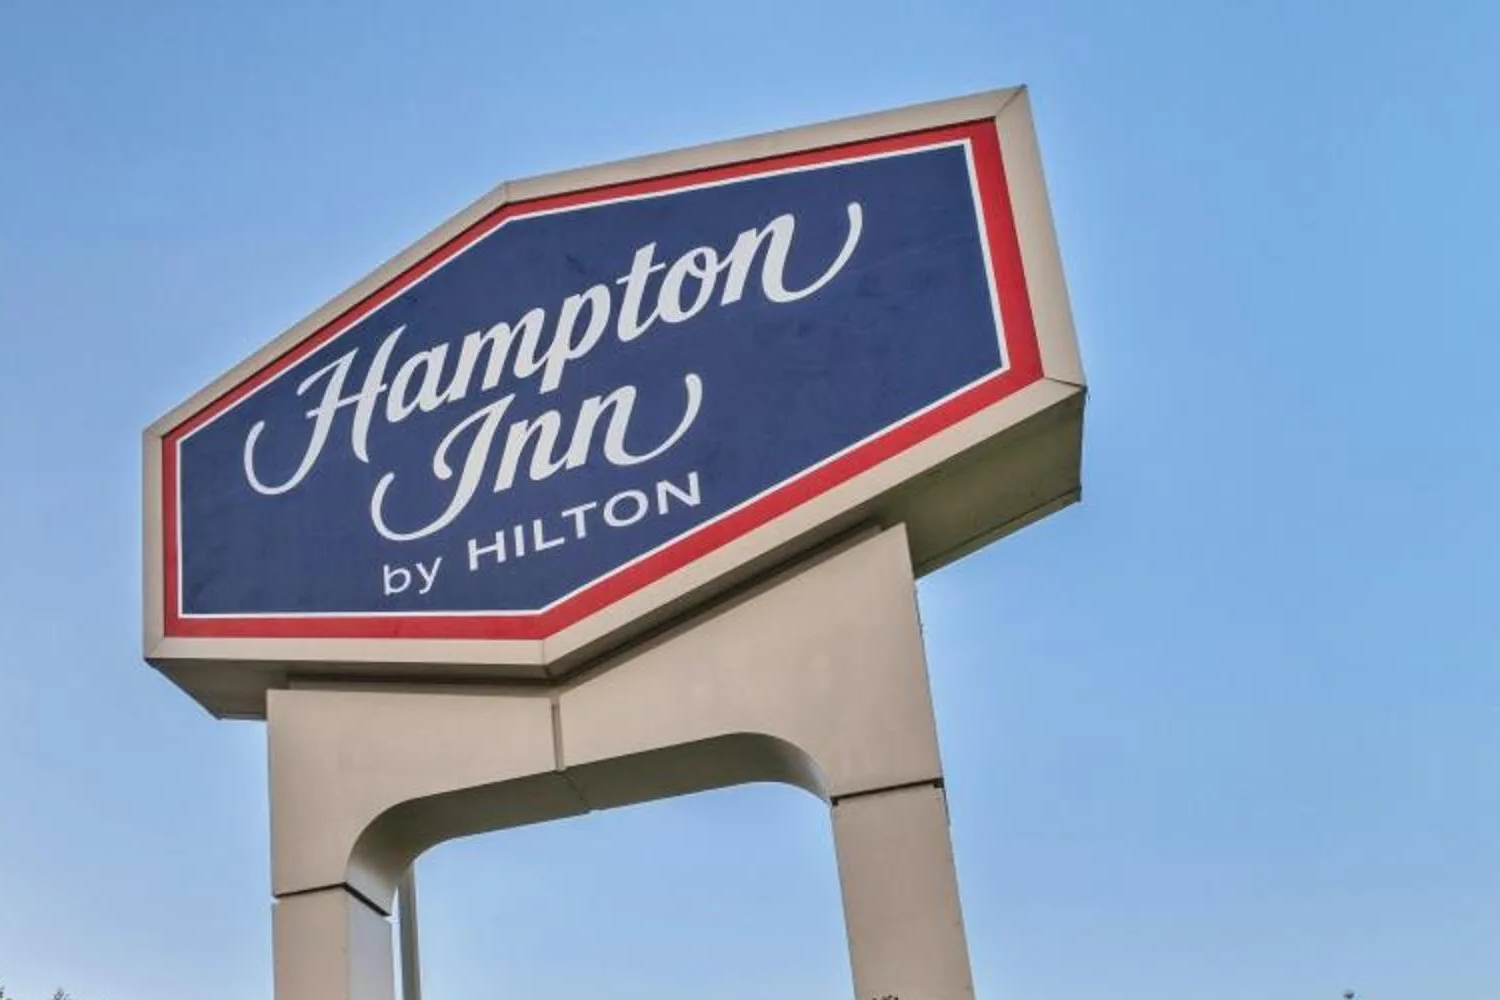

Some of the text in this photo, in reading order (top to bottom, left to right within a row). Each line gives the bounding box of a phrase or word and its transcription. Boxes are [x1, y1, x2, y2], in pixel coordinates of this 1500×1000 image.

[244, 202, 863, 495] Hampton
[371, 374, 703, 541] Inn
[383, 471, 701, 595] by HILTON
